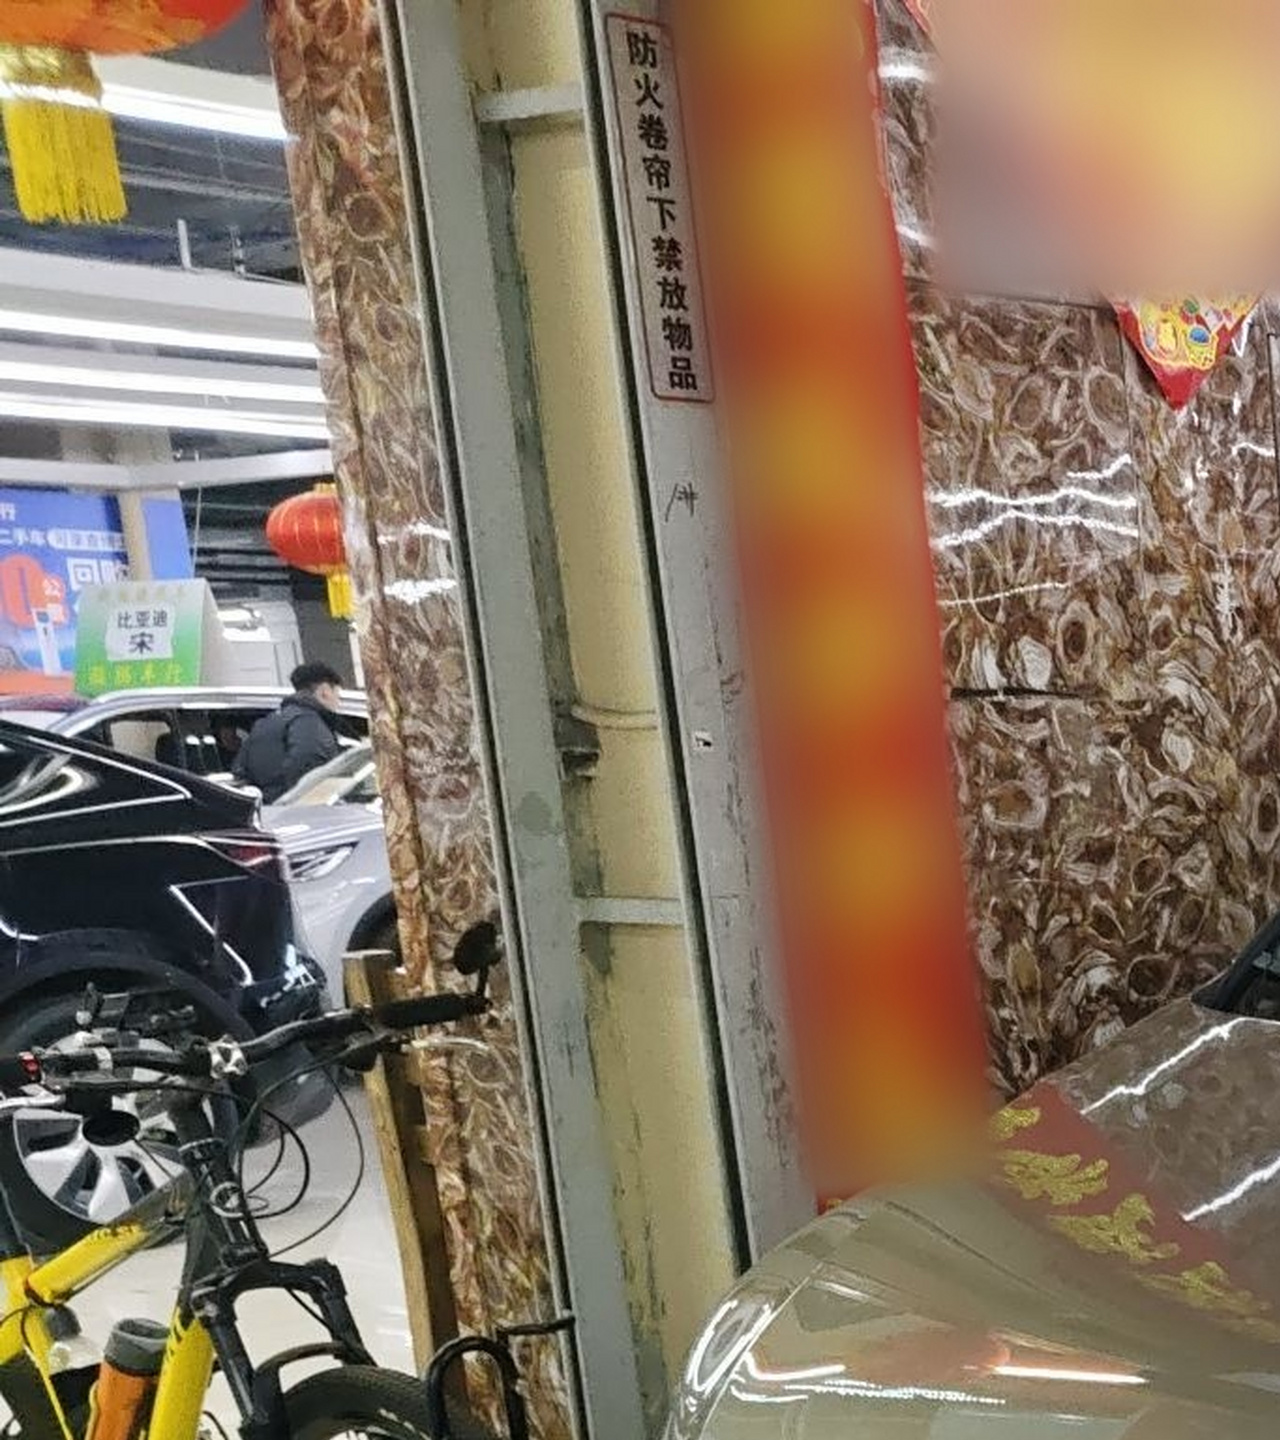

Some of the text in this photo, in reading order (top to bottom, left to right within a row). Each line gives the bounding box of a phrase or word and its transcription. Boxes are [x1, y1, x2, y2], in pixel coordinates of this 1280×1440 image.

[625, 30, 699, 391] 防火卷帘下禁放物品
[117, 609, 169, 629] 比亚迪
[128, 632, 155, 655] 宋
